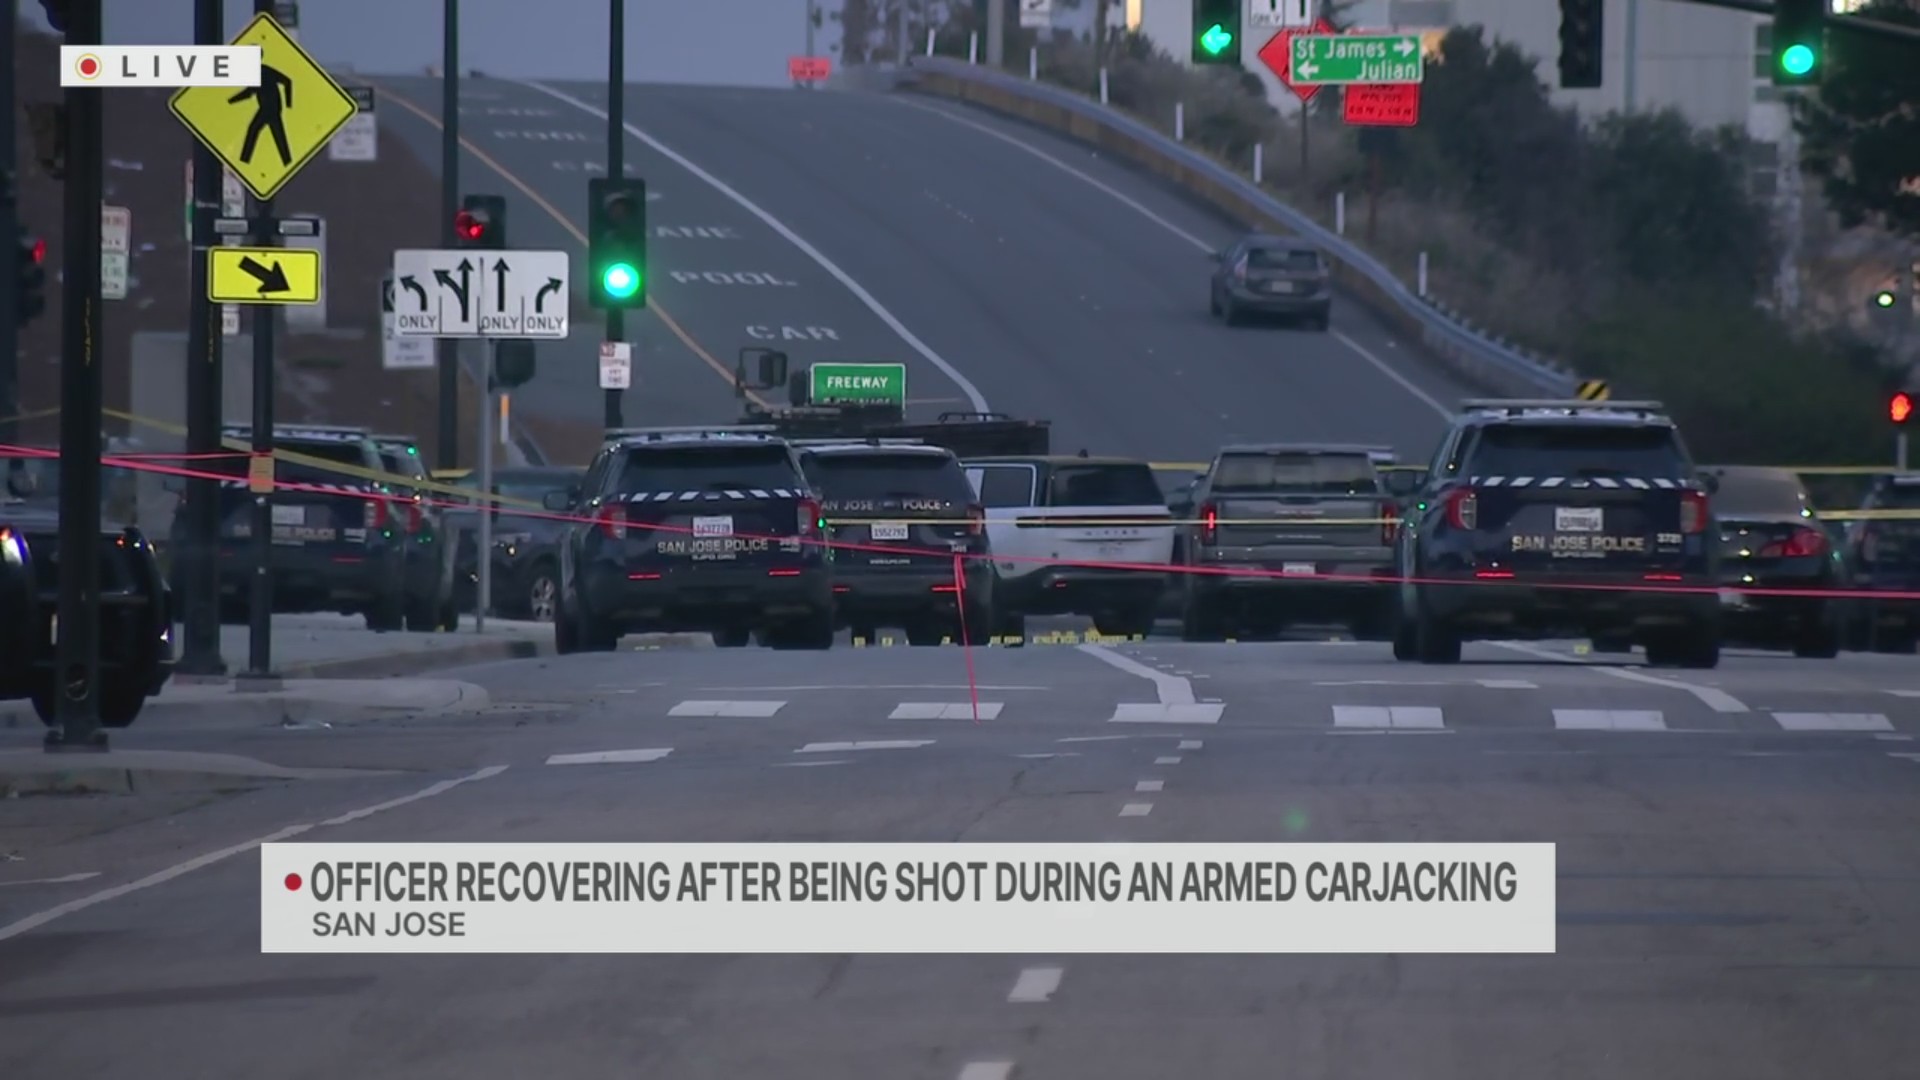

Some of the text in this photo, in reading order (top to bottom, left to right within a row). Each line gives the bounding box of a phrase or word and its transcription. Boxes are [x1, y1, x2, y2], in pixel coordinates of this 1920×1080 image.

[1296, 40, 1386, 60] St James
[1356, 60, 1416, 81] Julian
[669, 270, 798, 287] POOL
[400, 315, 564, 330] ONLY ONLY ONLY
[745, 325, 840, 341] CAR
[827, 376, 889, 389] FREEWAY
[821, 500, 941, 511] AN JOSE POLICE
[295, 527, 336, 540] POLICE
[657, 540, 685, 554] SAN
[689, 539, 722, 553] JOSE
[725, 538, 769, 552] POLICE
[1512, 535, 1644, 552] SAN JOSE POLICE
